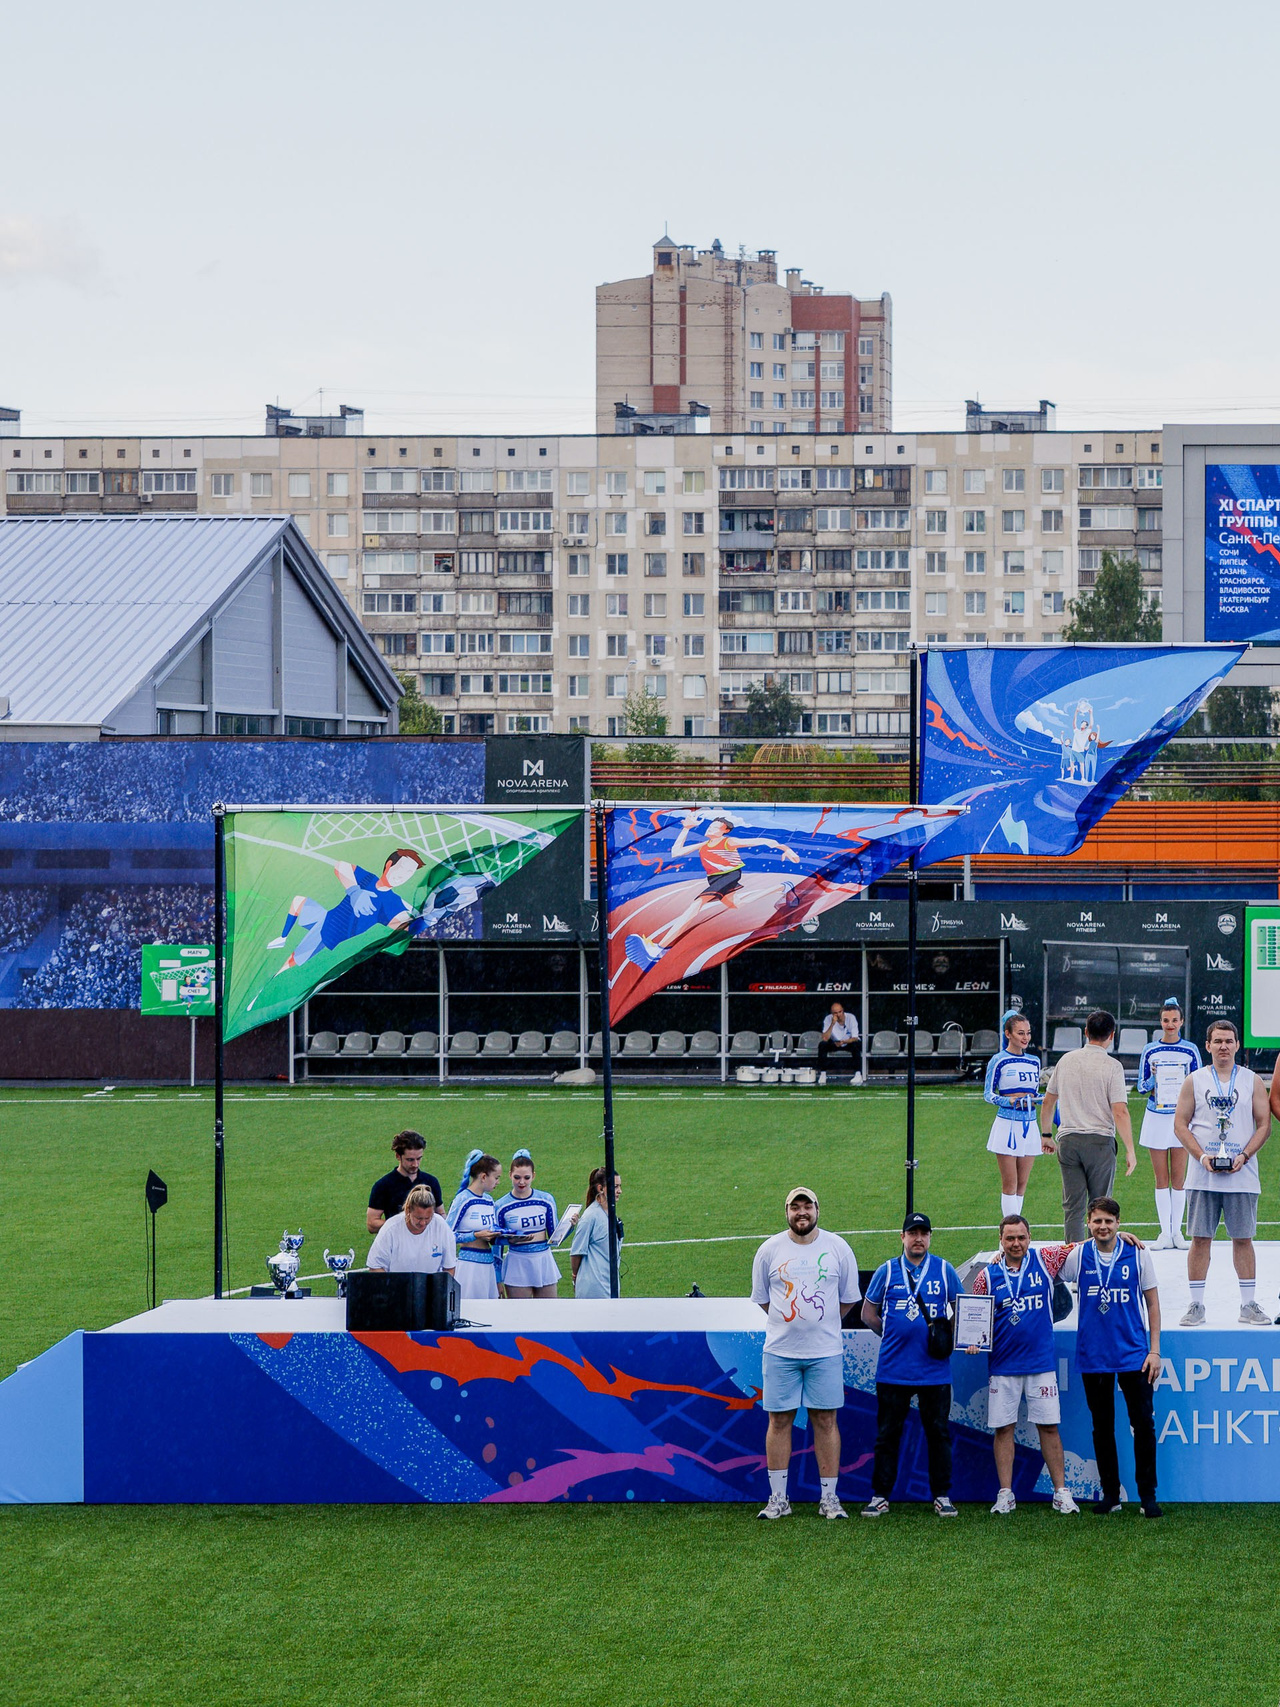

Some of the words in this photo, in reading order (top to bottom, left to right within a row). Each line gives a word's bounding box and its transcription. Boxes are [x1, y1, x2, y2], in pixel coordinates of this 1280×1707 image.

[1219, 499, 1233, 511] XI
[1219, 516, 1278, 528] ГРУППЫ
[498, 780, 528, 788] NOVA
[530, 780, 569, 788] ARENA
[1122, 1265, 1130, 1280] 9
[1028, 1271, 1042, 1288] 14
[927, 1281, 940, 1295] 13
